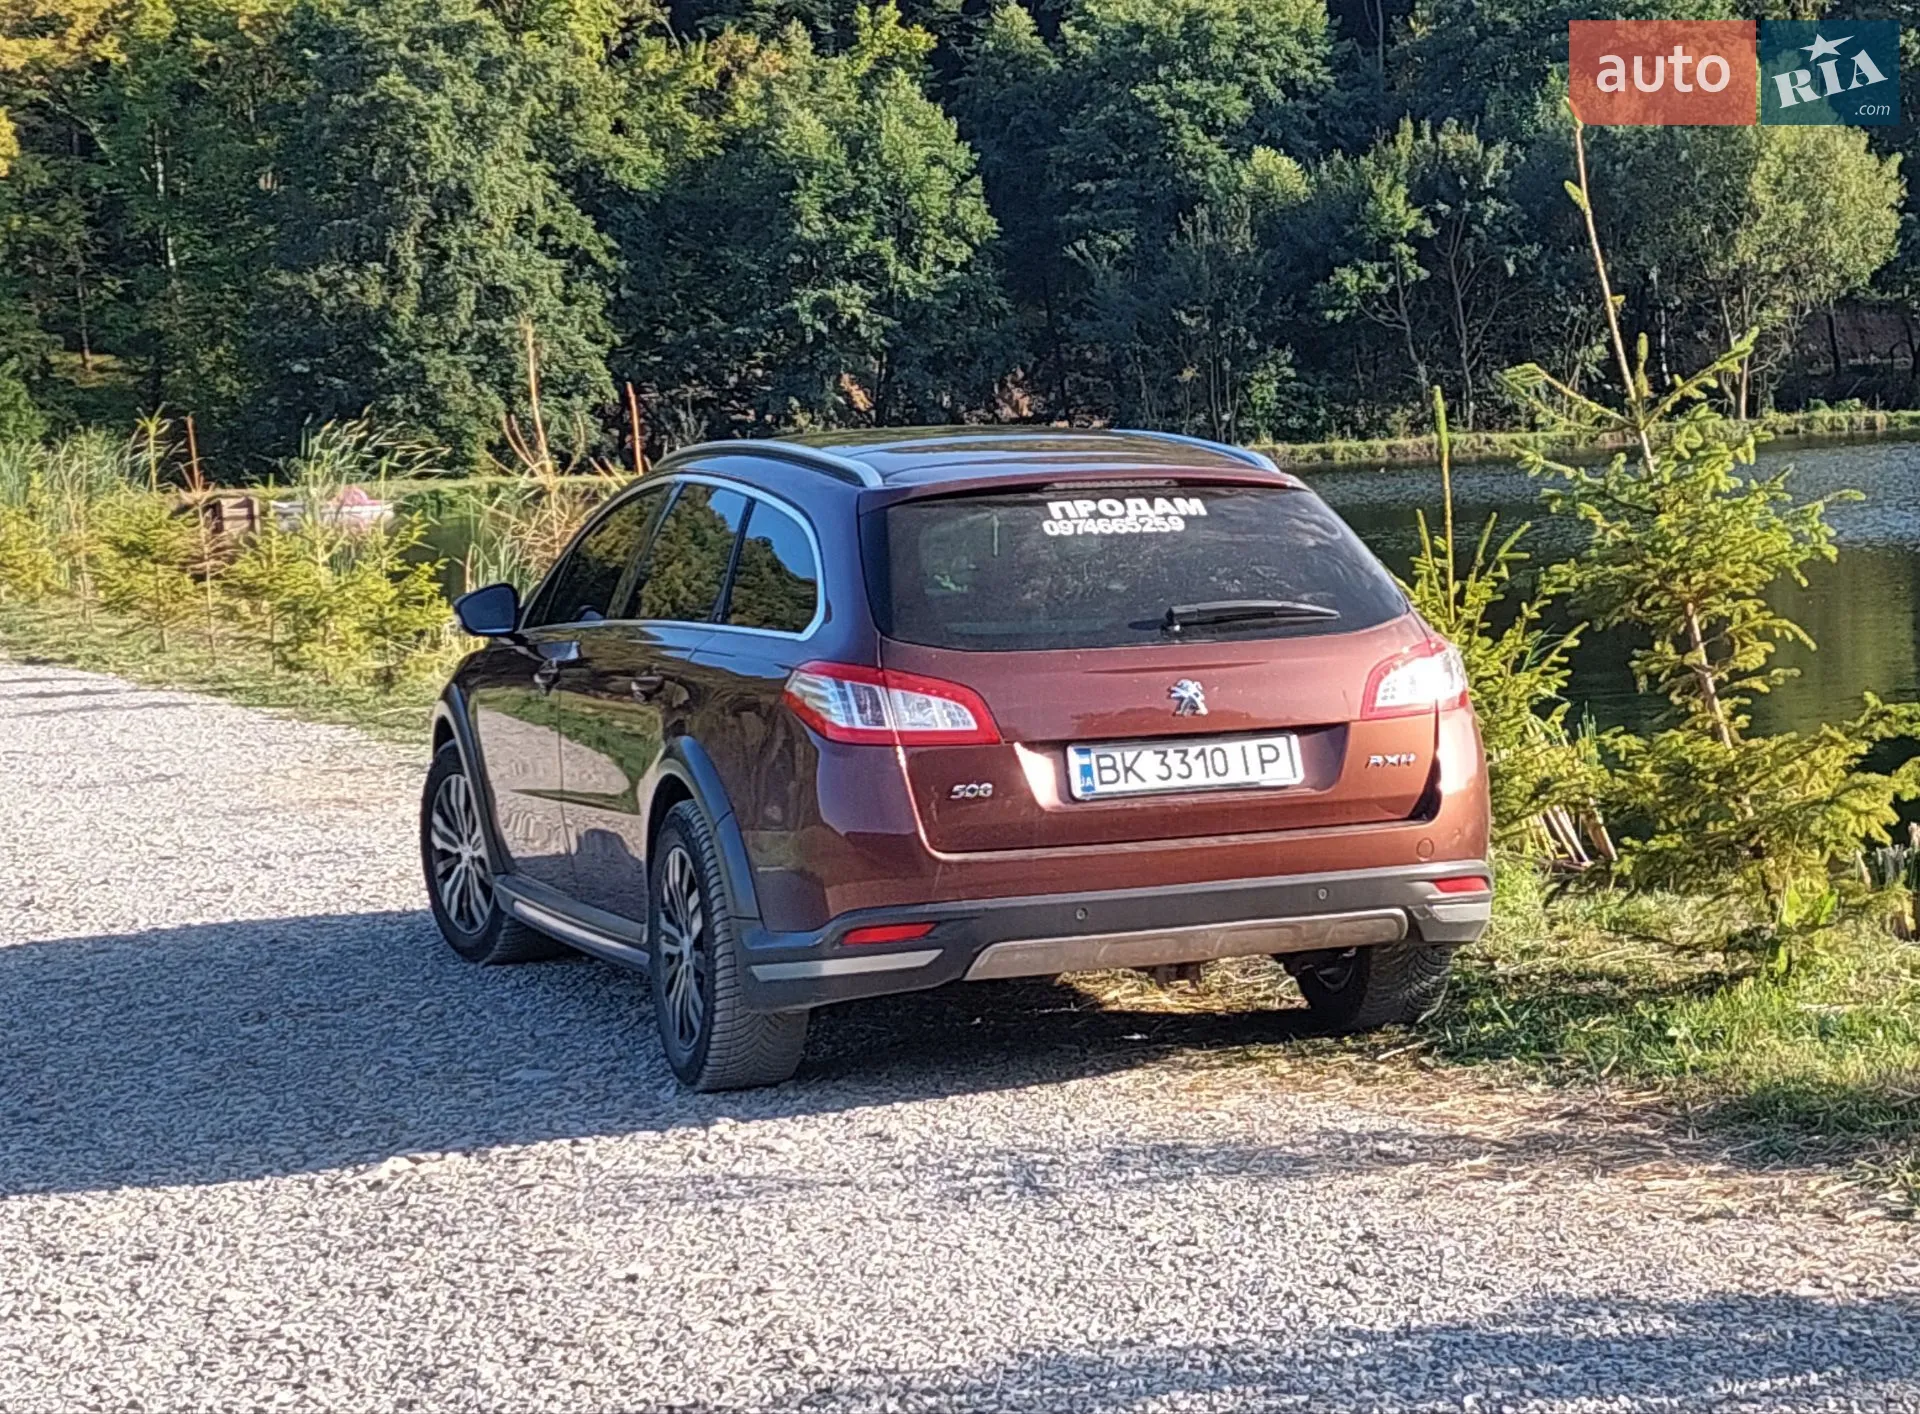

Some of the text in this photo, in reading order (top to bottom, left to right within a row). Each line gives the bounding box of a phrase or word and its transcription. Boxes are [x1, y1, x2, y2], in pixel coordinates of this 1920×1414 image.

[1047, 497, 1208, 519] ПРОДАМ
[1042, 516, 1185, 536] 0974665259
[1095, 749, 1147, 785] BK
[1153, 747, 1229, 781] 3310
